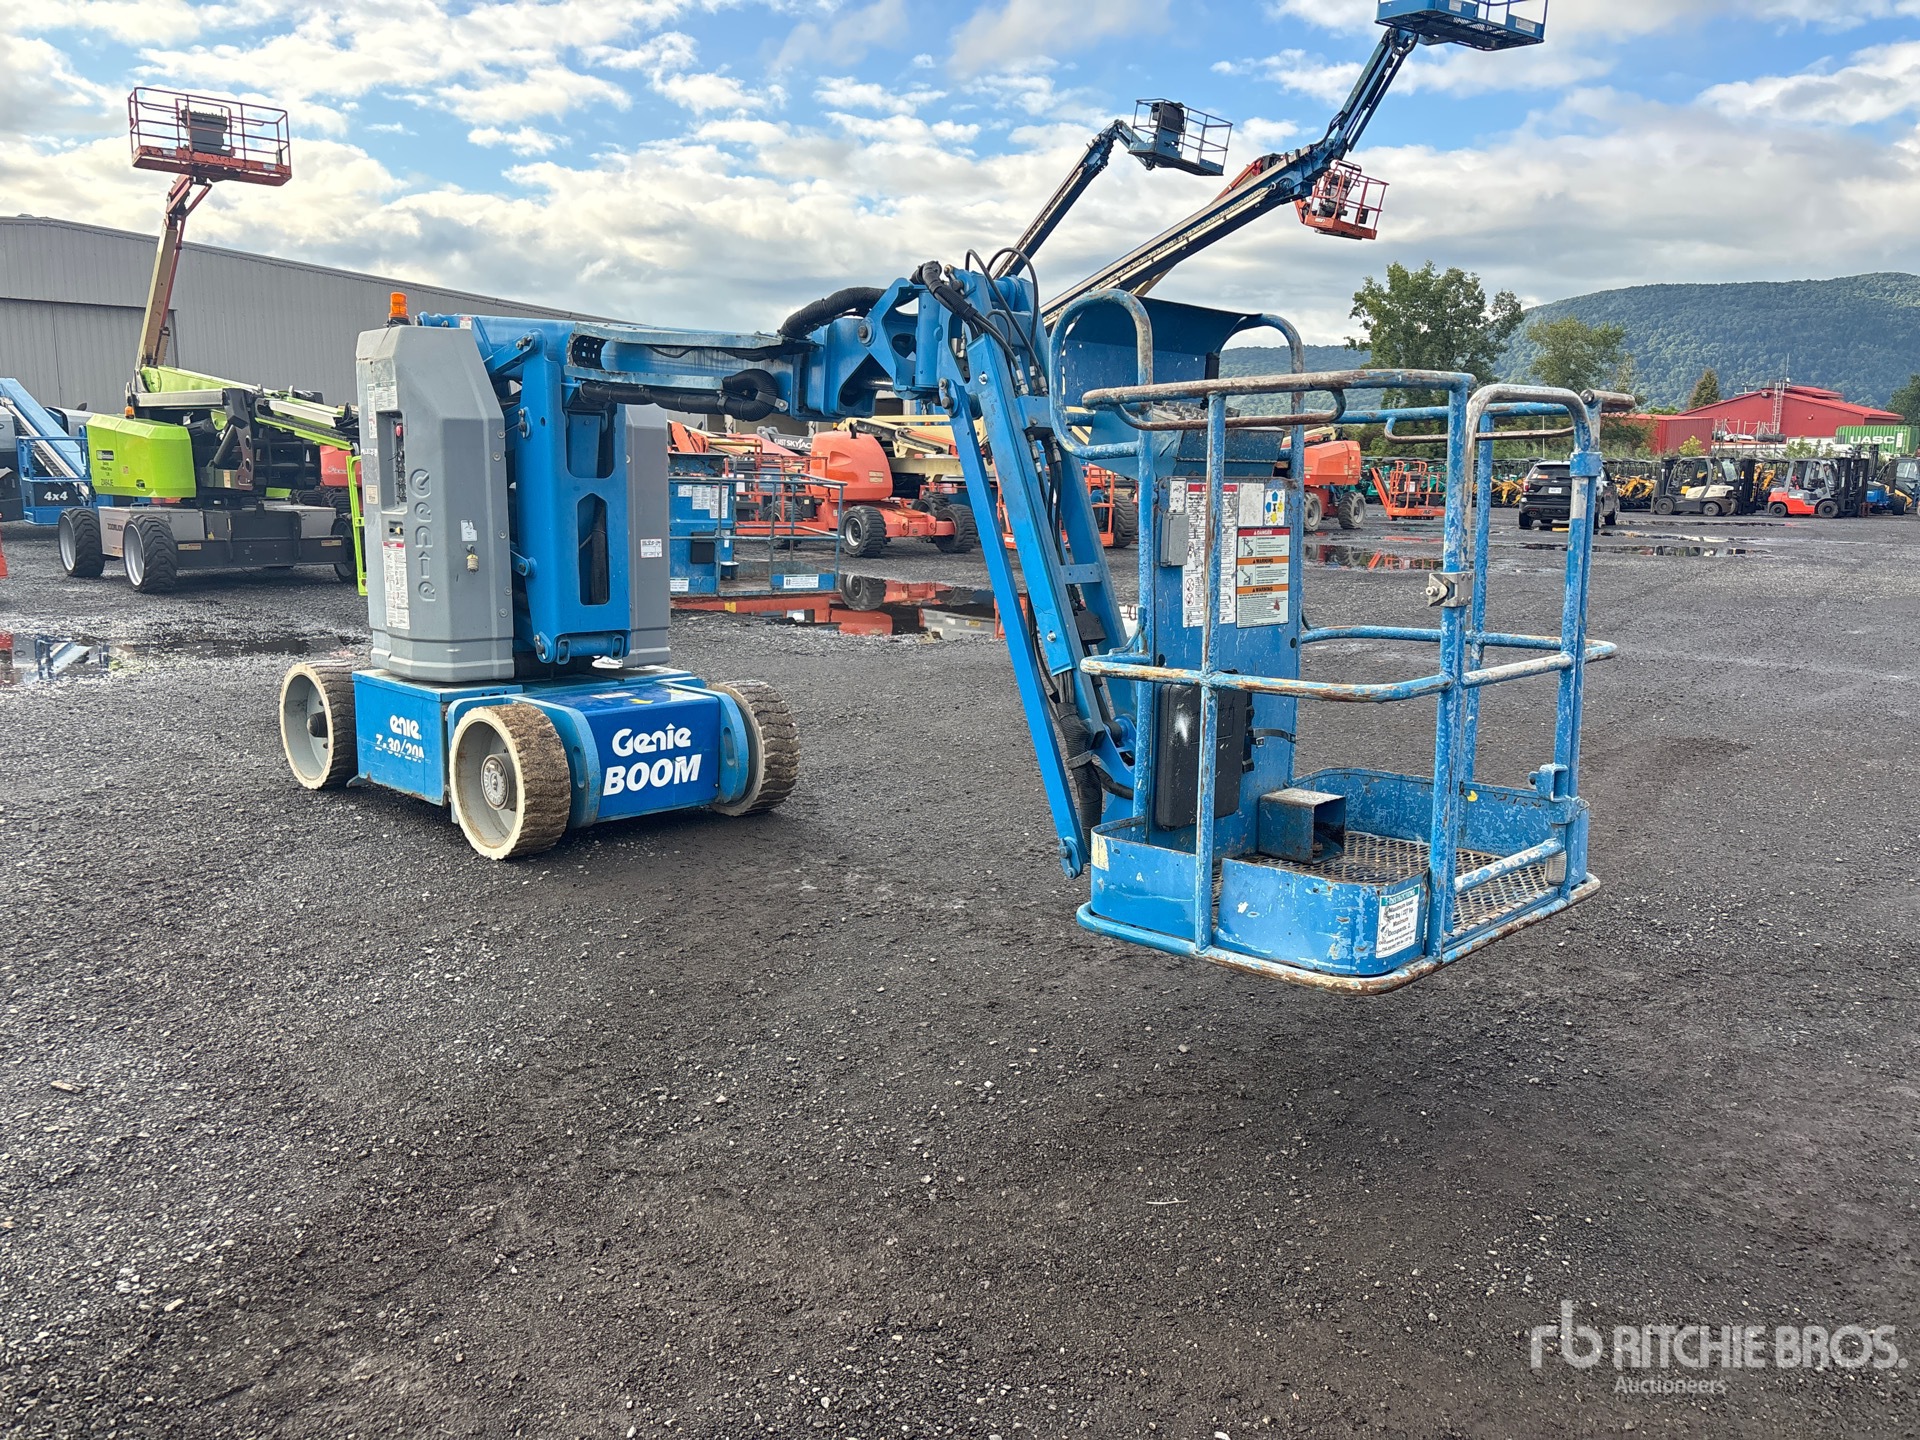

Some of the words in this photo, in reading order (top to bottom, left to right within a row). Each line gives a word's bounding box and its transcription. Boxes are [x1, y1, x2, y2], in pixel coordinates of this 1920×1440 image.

[787, 438, 812, 449] SKYJAC
[1849, 435, 1896, 444] UASC
[43, 491, 68, 501] 4x4
[409, 468, 436, 602] Genie
[612, 723, 692, 757] Genie
[603, 753, 702, 796] BOOM
